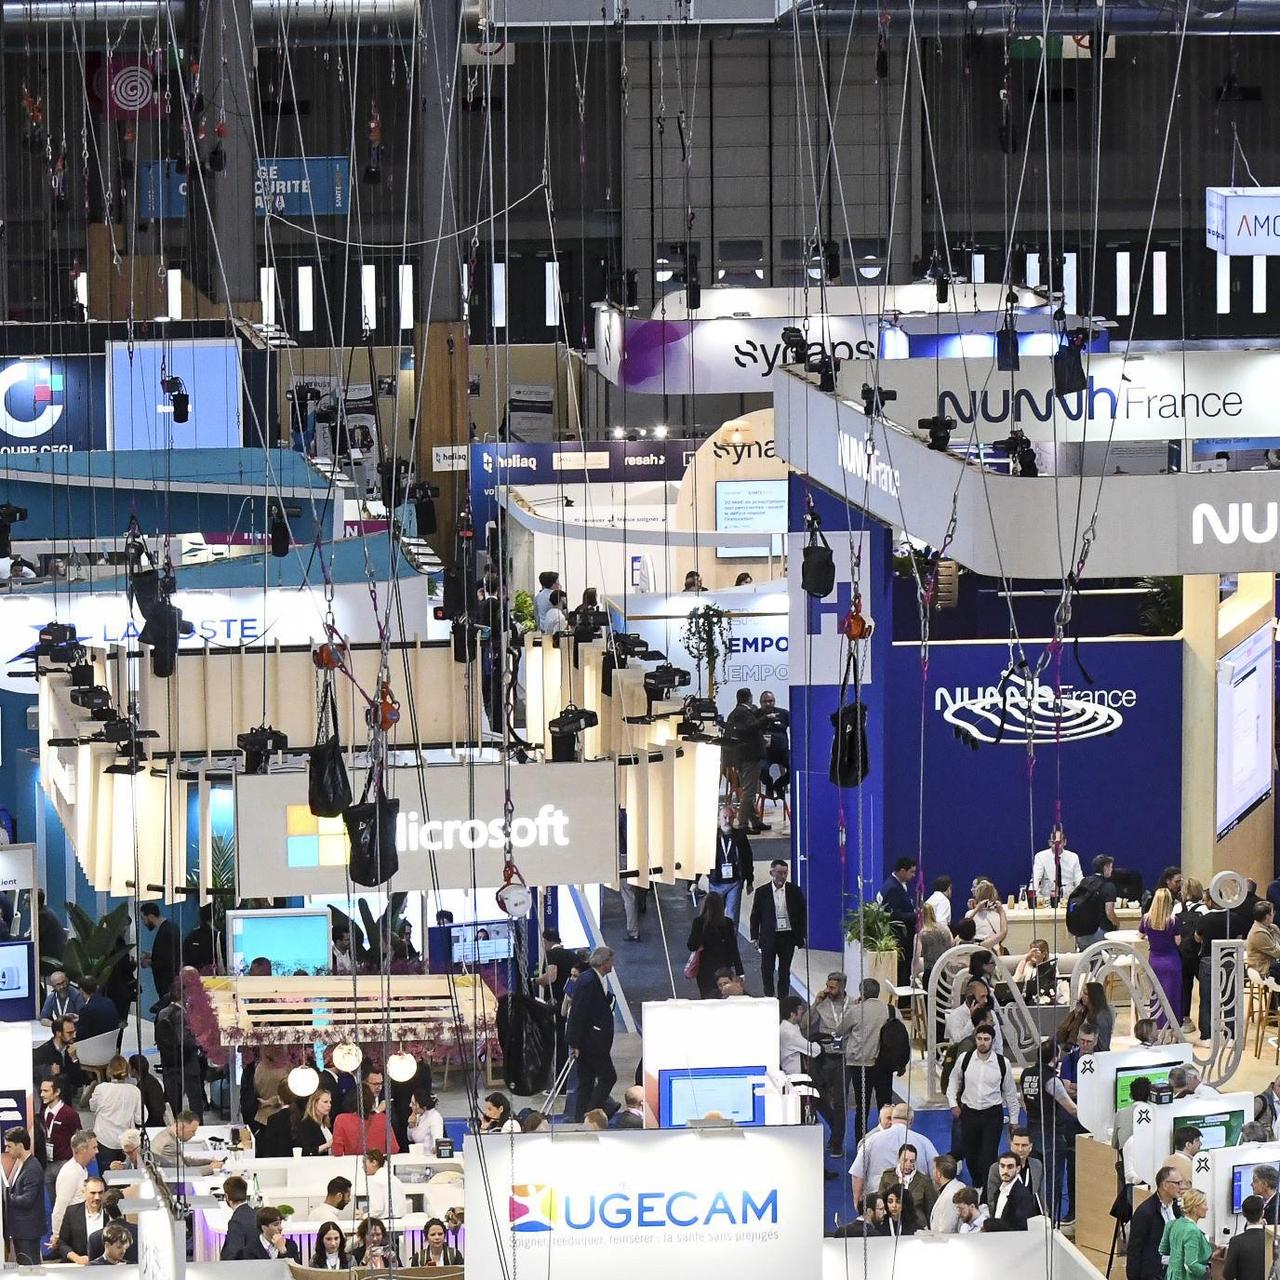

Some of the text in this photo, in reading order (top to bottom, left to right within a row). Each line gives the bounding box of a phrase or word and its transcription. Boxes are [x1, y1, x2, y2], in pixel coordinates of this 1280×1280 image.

[1125, 386, 1243, 419] France
[624, 454, 658, 466] resah
[397, 803, 570, 854] icrosoft
[564, 1188, 779, 1230] UGECAM
